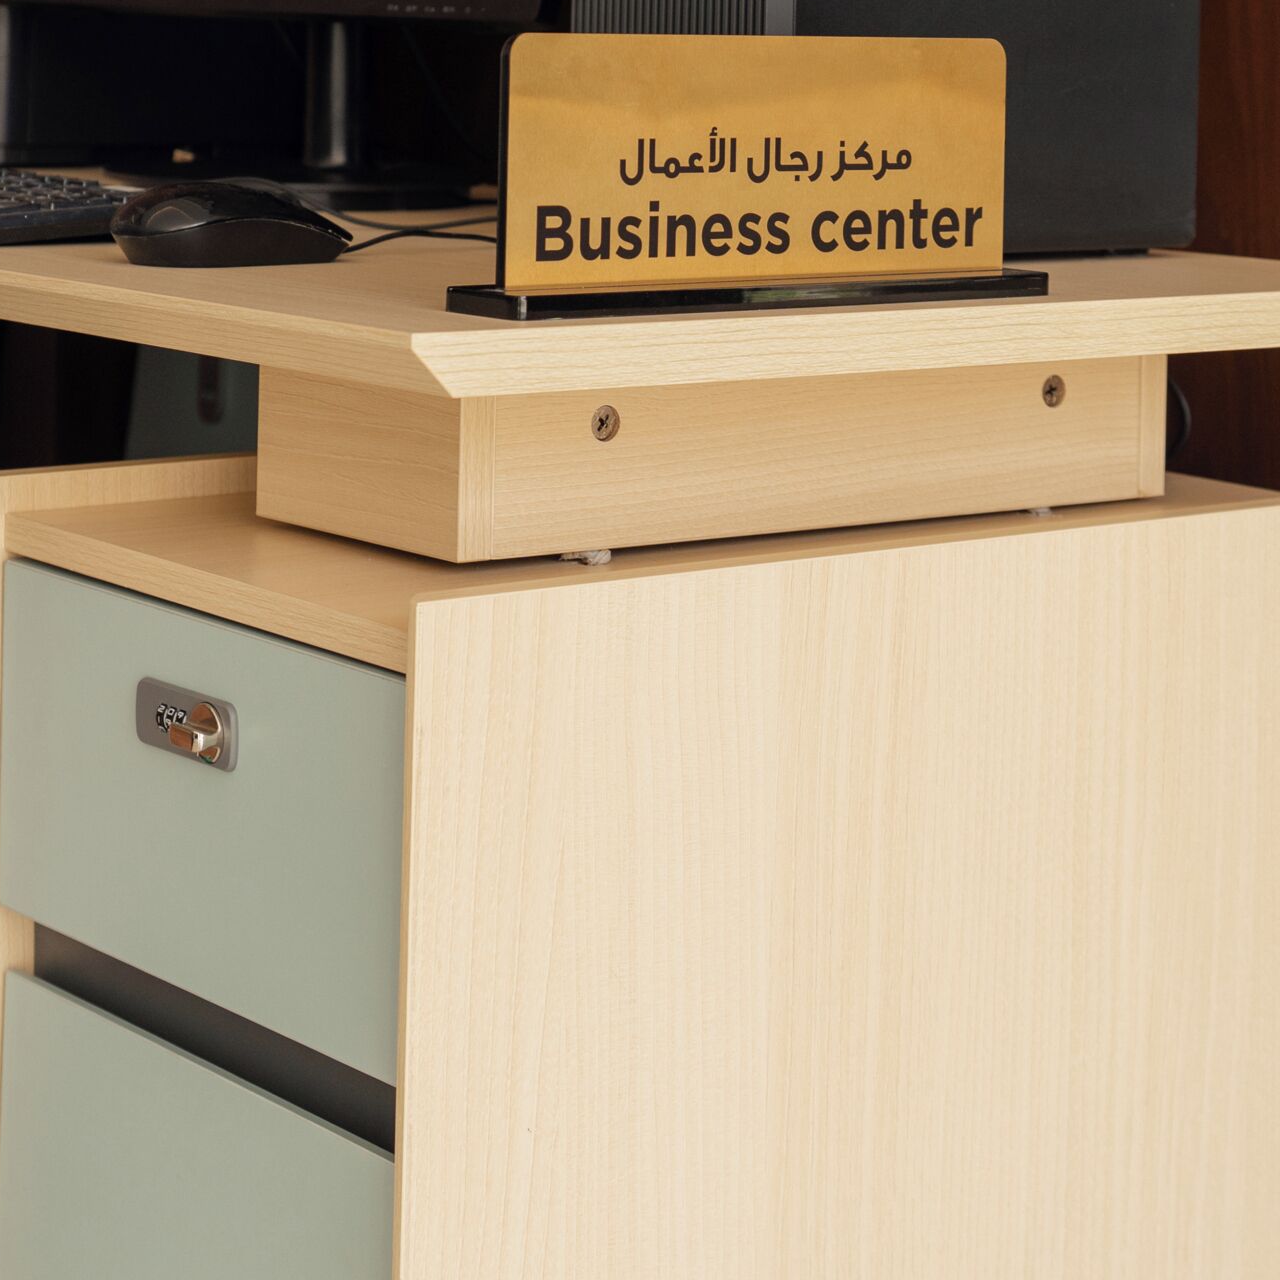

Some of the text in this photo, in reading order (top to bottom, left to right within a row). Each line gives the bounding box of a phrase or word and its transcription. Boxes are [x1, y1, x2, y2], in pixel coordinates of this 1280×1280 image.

[619, 126, 912, 186] مركز رجال الأعمال
[535, 198, 983, 262] Business center
